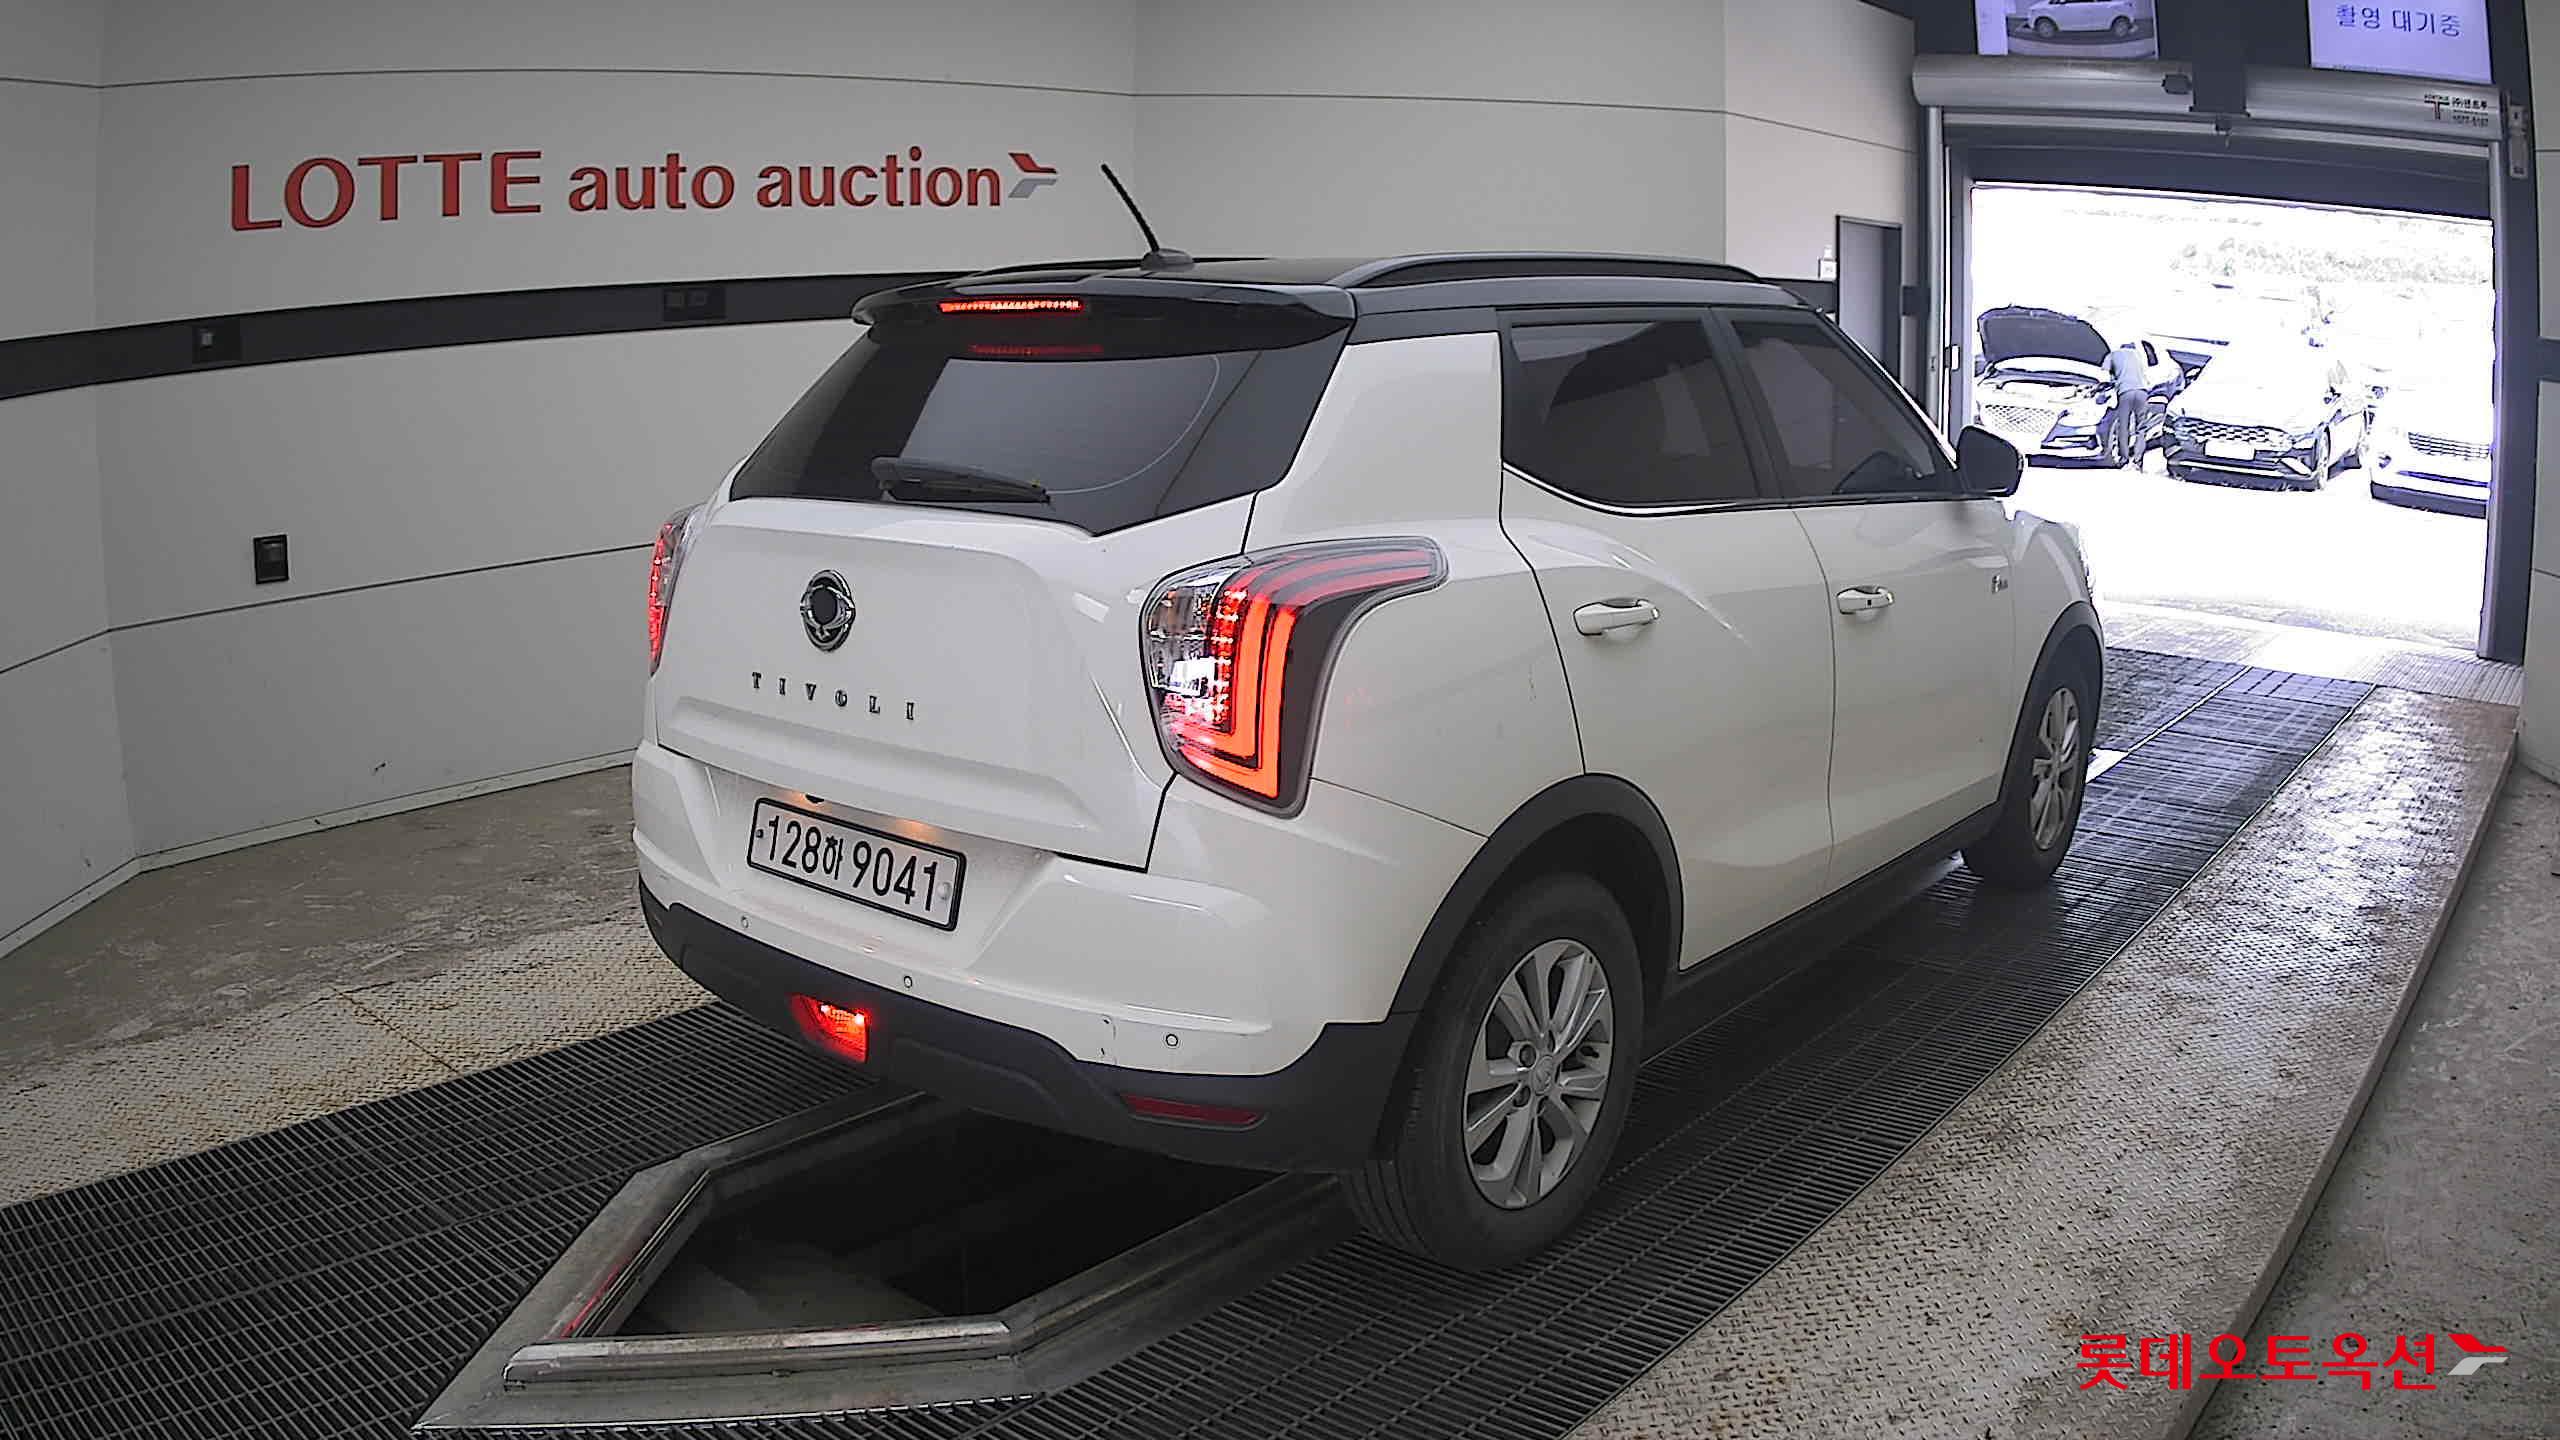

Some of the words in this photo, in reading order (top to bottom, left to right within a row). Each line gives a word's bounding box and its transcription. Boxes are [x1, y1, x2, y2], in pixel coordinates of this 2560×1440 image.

[2336, 4, 2381, 30] 촬영
[2392, 9, 2462, 38] 대기중
[231, 151, 543, 232] LOTTE
[568, 152, 736, 213] auto
[756, 146, 1001, 210] auction
[751, 671, 916, 721] TIVOLI
[852, 840, 939, 912] 9041
